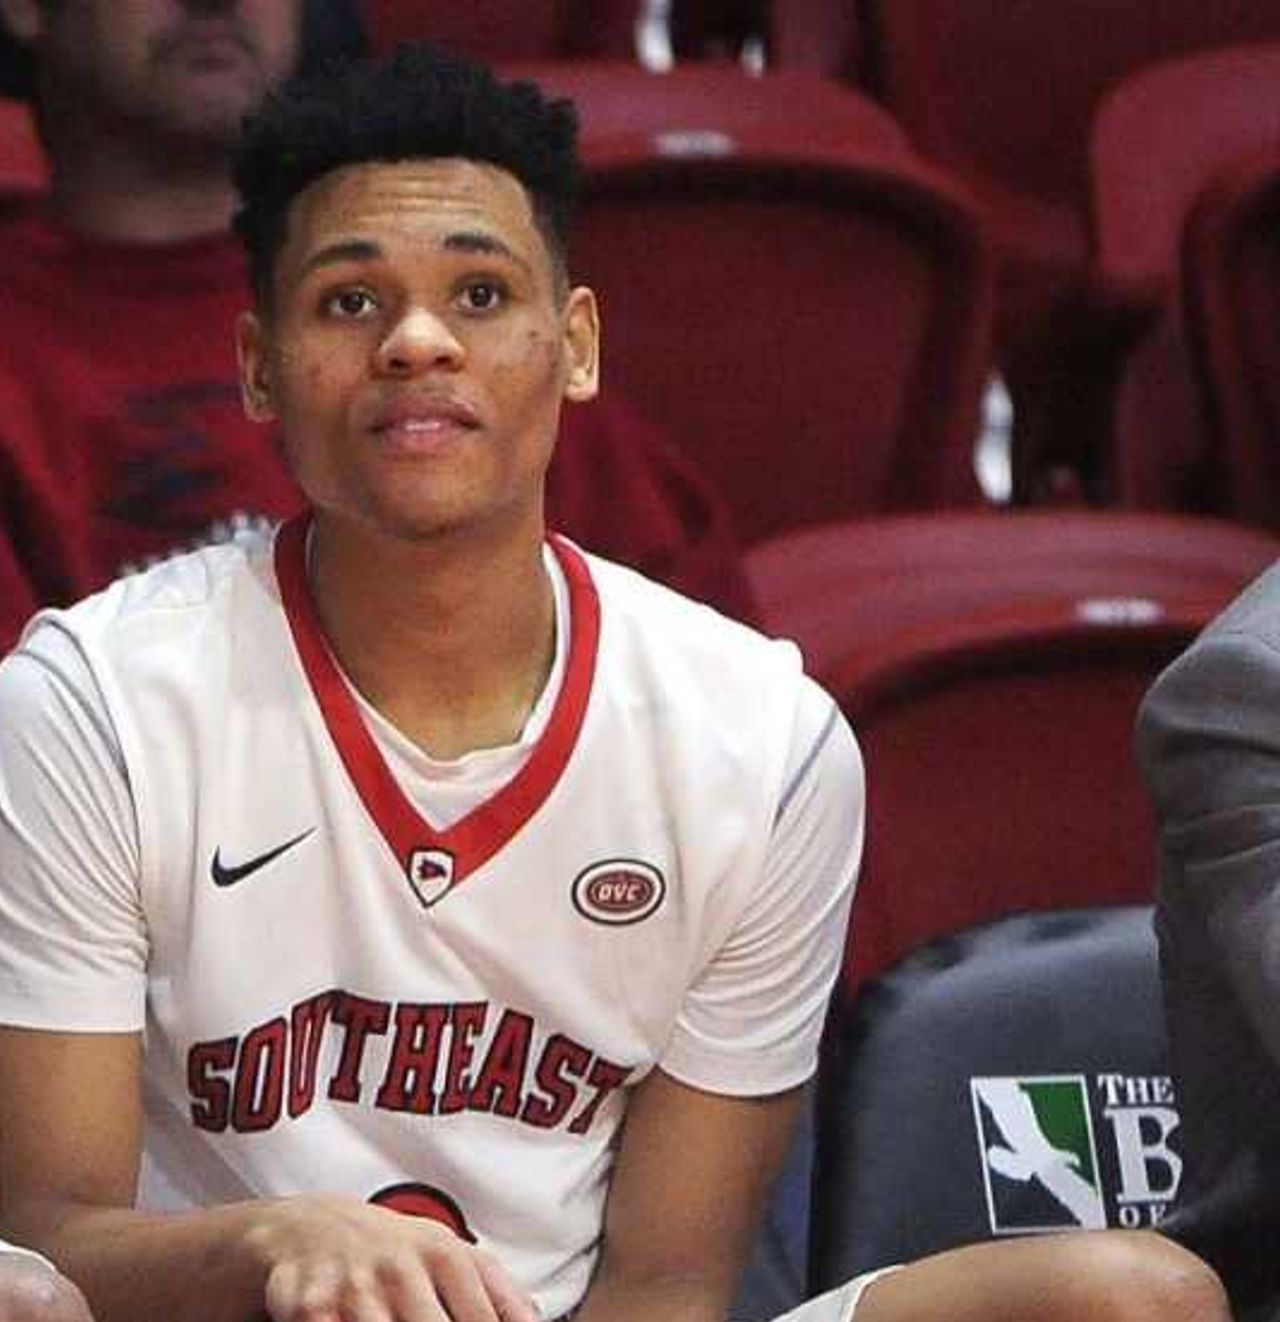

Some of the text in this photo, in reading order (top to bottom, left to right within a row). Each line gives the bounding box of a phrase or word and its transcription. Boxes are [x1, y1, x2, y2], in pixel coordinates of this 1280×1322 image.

[598, 881, 642, 902] OVC
[186, 989, 634, 1136] SOUTHEAST
[1097, 1074, 1174, 1105] THE
[1104, 1106, 1183, 1203] B
